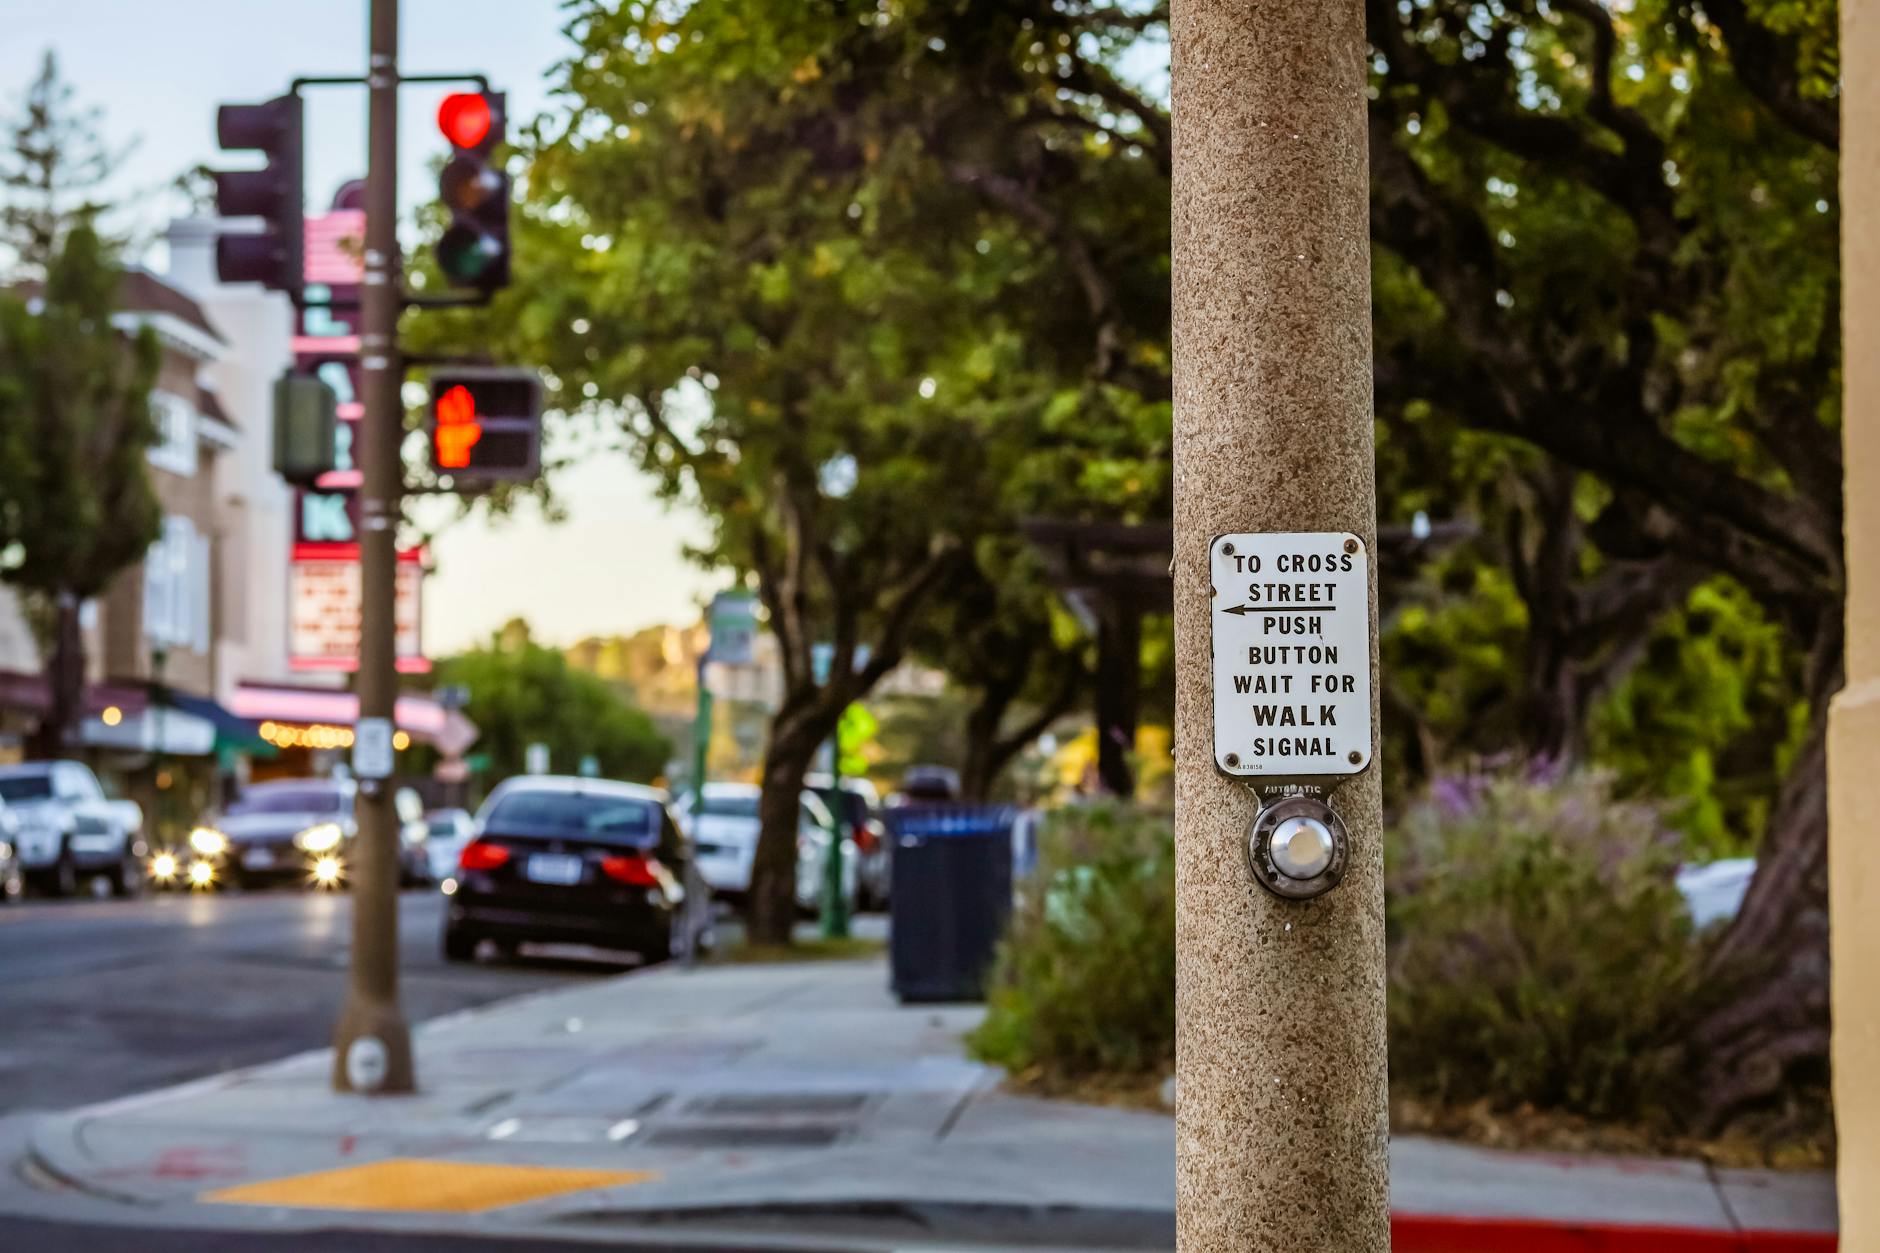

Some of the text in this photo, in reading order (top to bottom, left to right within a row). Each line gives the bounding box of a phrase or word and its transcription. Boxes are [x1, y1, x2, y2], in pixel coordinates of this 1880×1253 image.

[1233, 553, 1353, 573] TO CROSS
[1248, 583, 1337, 602] STREET
[1263, 616, 1322, 635] PUSH
[1248, 646, 1338, 665] BUTTON
[1233, 675, 1355, 694] WAIT FOR
[1252, 705, 1337, 726] WALK
[1253, 737, 1337, 756] SIGNAL
